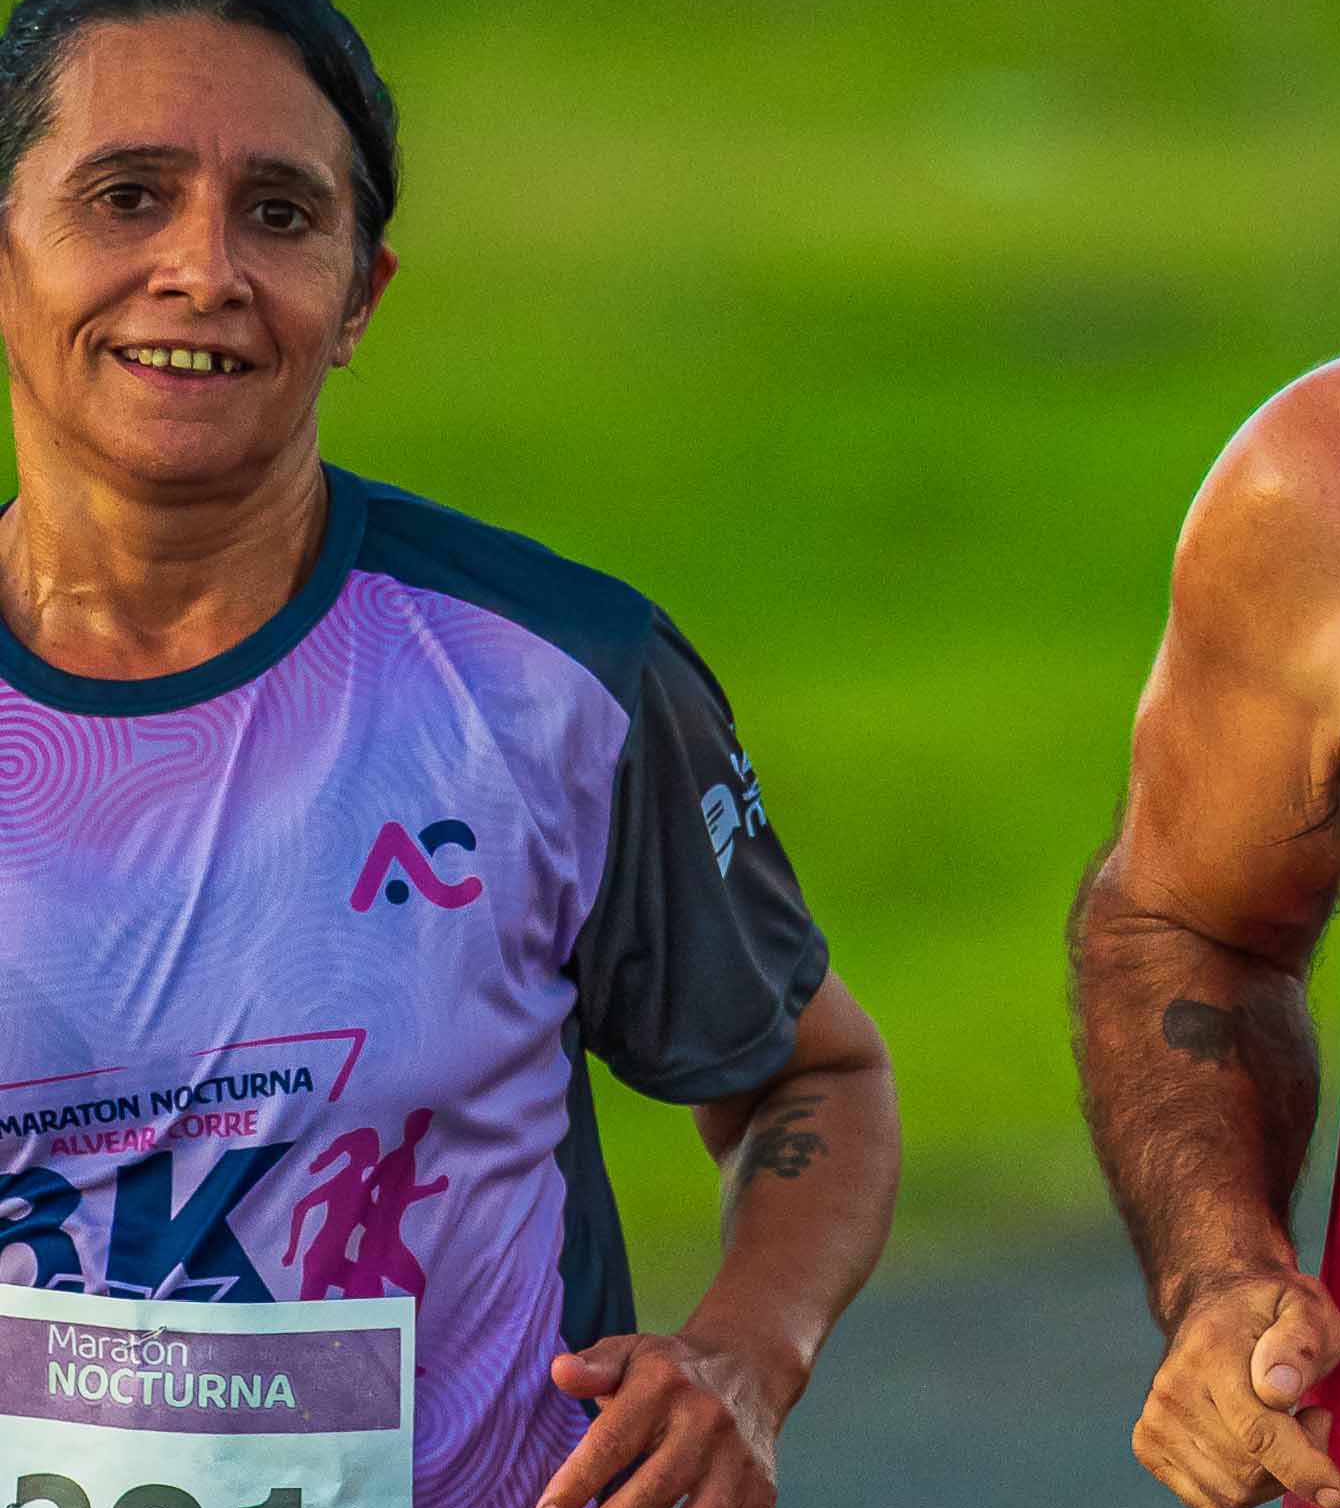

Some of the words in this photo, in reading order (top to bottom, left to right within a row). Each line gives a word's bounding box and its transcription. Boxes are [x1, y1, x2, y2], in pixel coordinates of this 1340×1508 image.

[0, 1094, 141, 1139] MARATON
[150, 1066, 314, 1116] NOCTURNA
[51, 1127, 159, 1156] ALVEAR
[168, 1109, 257, 1140] CORRE
[48, 1361, 296, 1409] NOCTURNA
